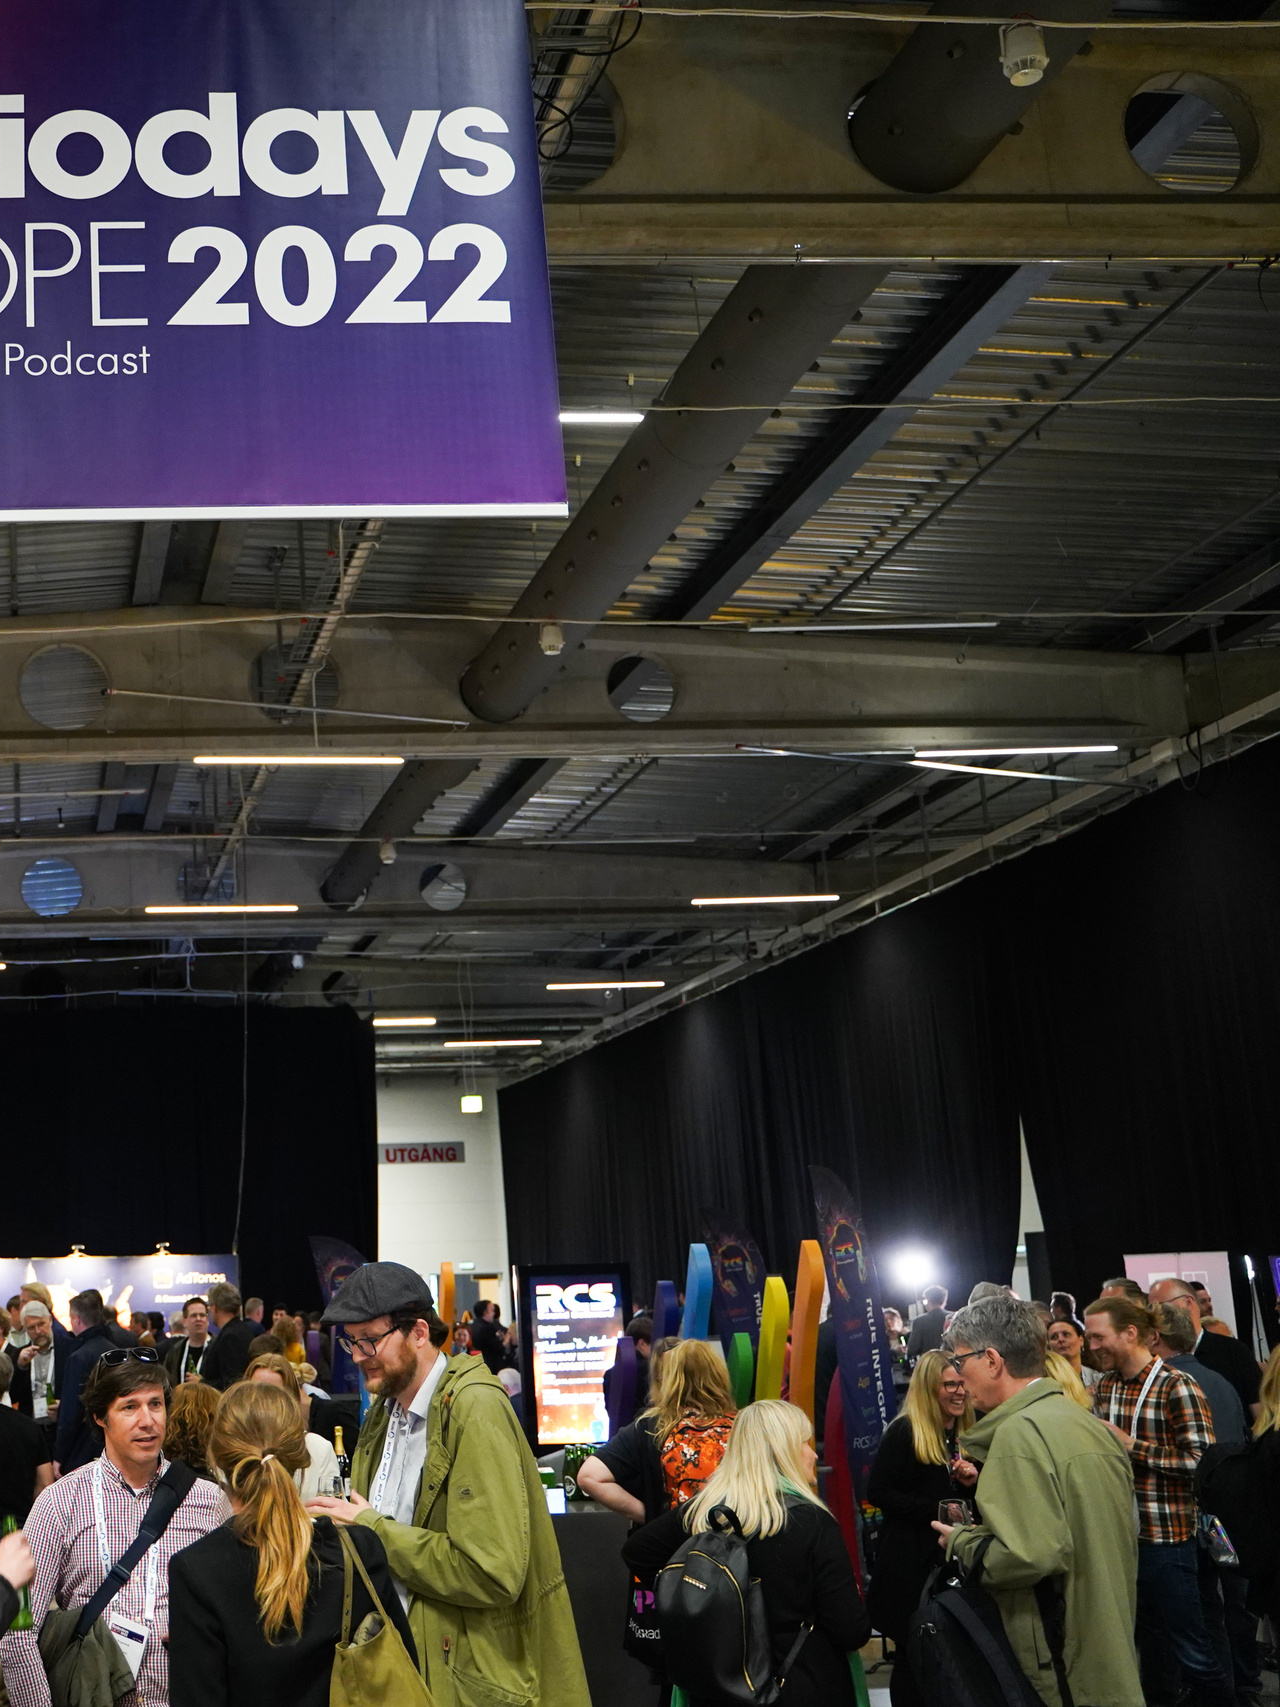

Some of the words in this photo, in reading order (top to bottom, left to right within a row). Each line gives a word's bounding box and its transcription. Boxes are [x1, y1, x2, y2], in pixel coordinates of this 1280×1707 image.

[166, 222, 512, 327] 2022
[4, 340, 151, 377] Podcast
[385, 1145, 457, 1163] UTGÅNG
[175, 1271, 226, 1284] AdTonos
[536, 1283, 616, 1312] RCS
[865, 1297, 878, 1344] TRUE
